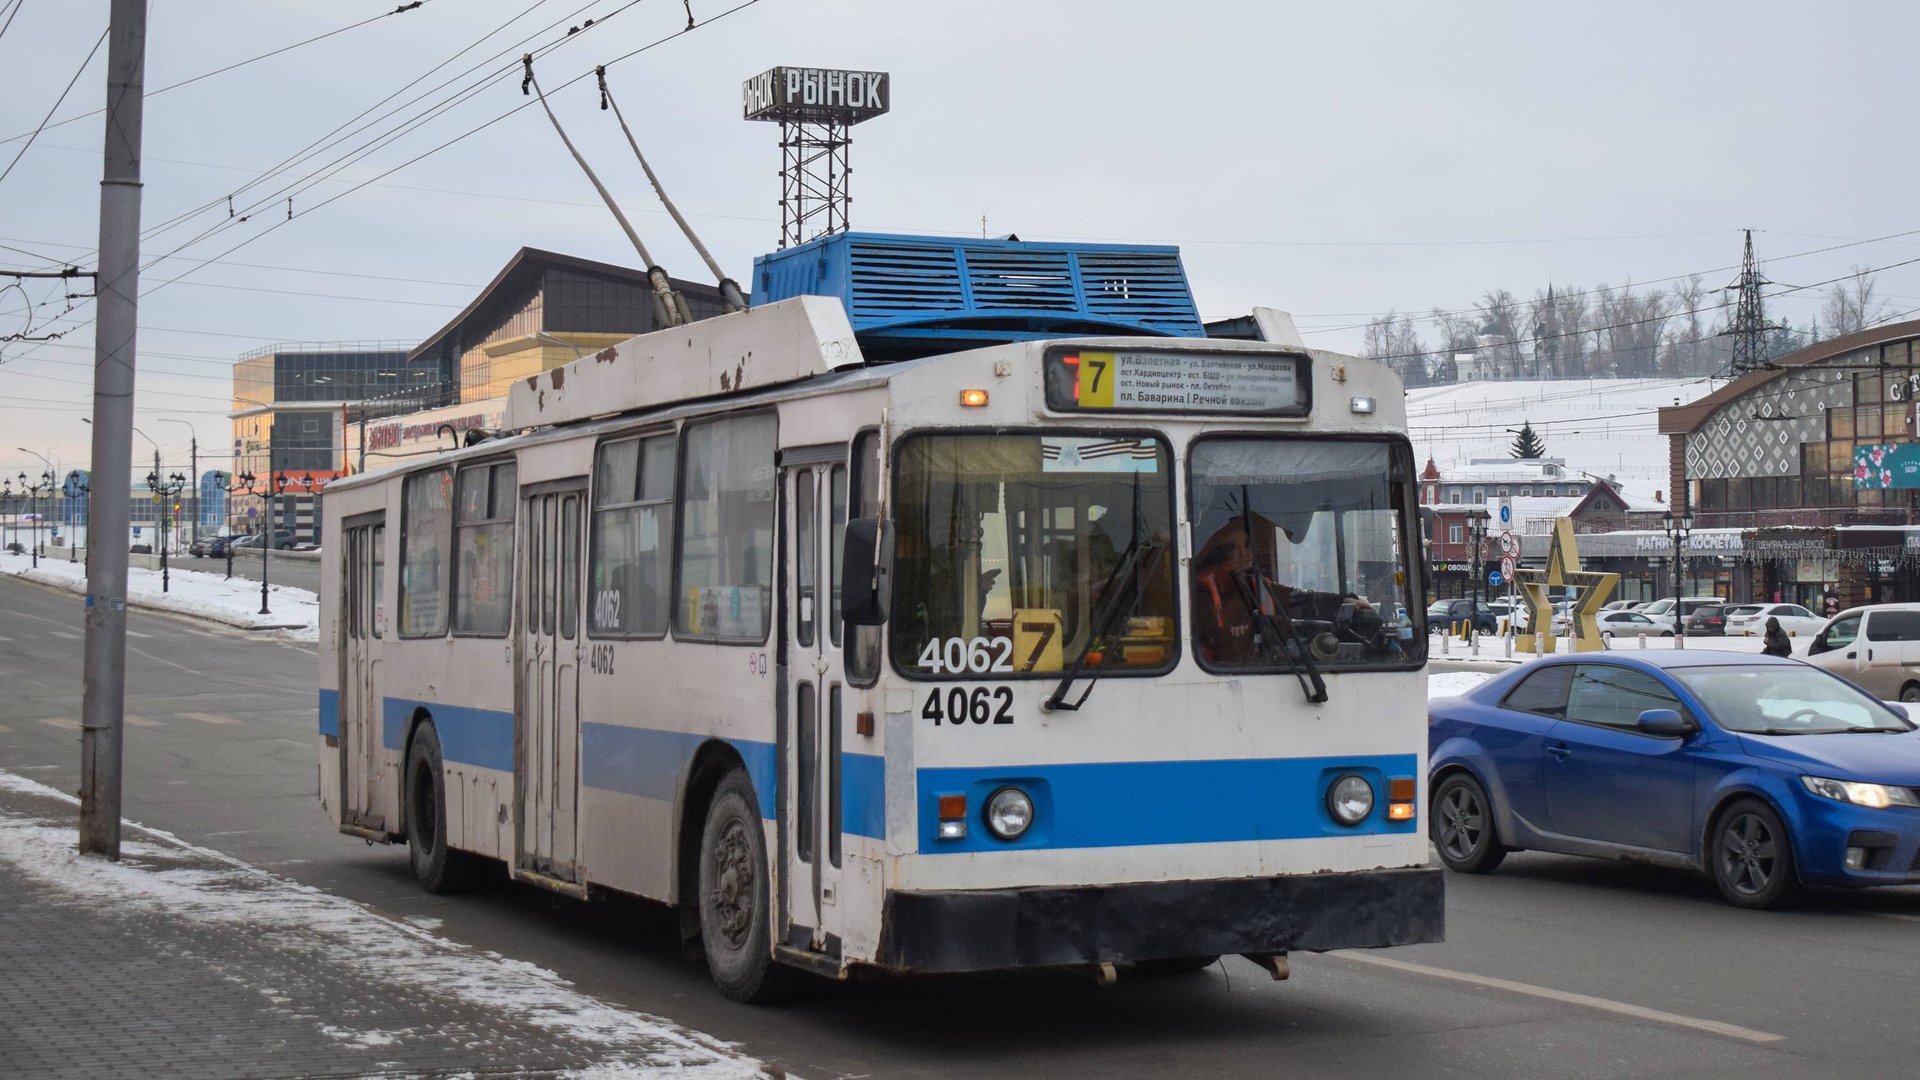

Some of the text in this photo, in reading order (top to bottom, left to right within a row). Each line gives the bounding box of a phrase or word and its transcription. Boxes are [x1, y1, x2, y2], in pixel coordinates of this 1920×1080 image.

[744, 70, 774, 115] РЫНОК
[786, 68, 883, 109] РЫНОК
[1088, 360, 1106, 393] 7
[1121, 369, 1182, 379] ост.Кардиоцентр
[1136, 379, 1160, 388] Новый
[1248, 363, 1291, 372] ул.Малахова
[1120, 392, 1135, 401] пл.
[1138, 391, 1185, 403] Баварина
[1193, 393, 1227, 405] Речной
[1690, 534, 1743, 549] КОСМЕТИК
[1758, 538, 1825, 549] ЦЕНТРАЛЬНЫЙ ВХОД
[595, 589, 620, 628] 4062
[591, 644, 614, 675] 4062
[918, 636, 1013, 674] 4062
[1021, 622, 1055, 672] 7
[922, 686, 1014, 726] 4062
